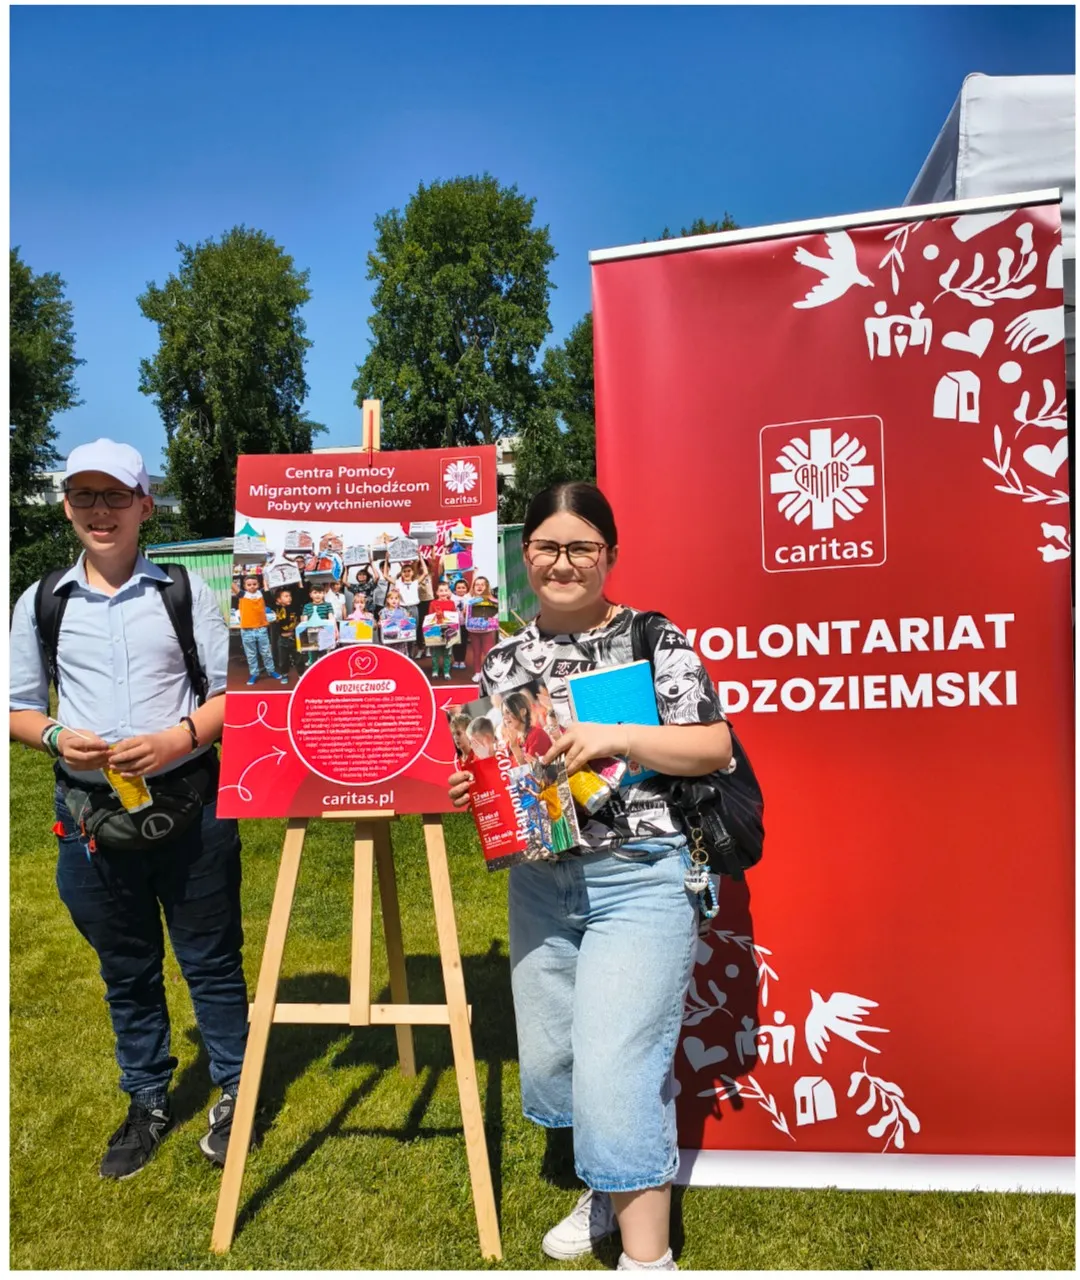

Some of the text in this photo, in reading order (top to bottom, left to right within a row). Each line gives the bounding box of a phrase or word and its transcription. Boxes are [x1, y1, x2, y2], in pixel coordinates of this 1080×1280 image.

[285, 465, 395, 481] Centra Pomocy
[249, 481, 429, 498] Migrantom i Uchodźcom
[267, 497, 412, 513] Pobyty wytchnieniowe
[444, 495, 478, 505] caritas
[774, 537, 874, 564] caritas
[336, 681, 391, 694] WDZIĘCZNOŚĆ
[714, 670, 1017, 714] DZOZIEMSKI
[322, 790, 394, 807] caritas.pl
